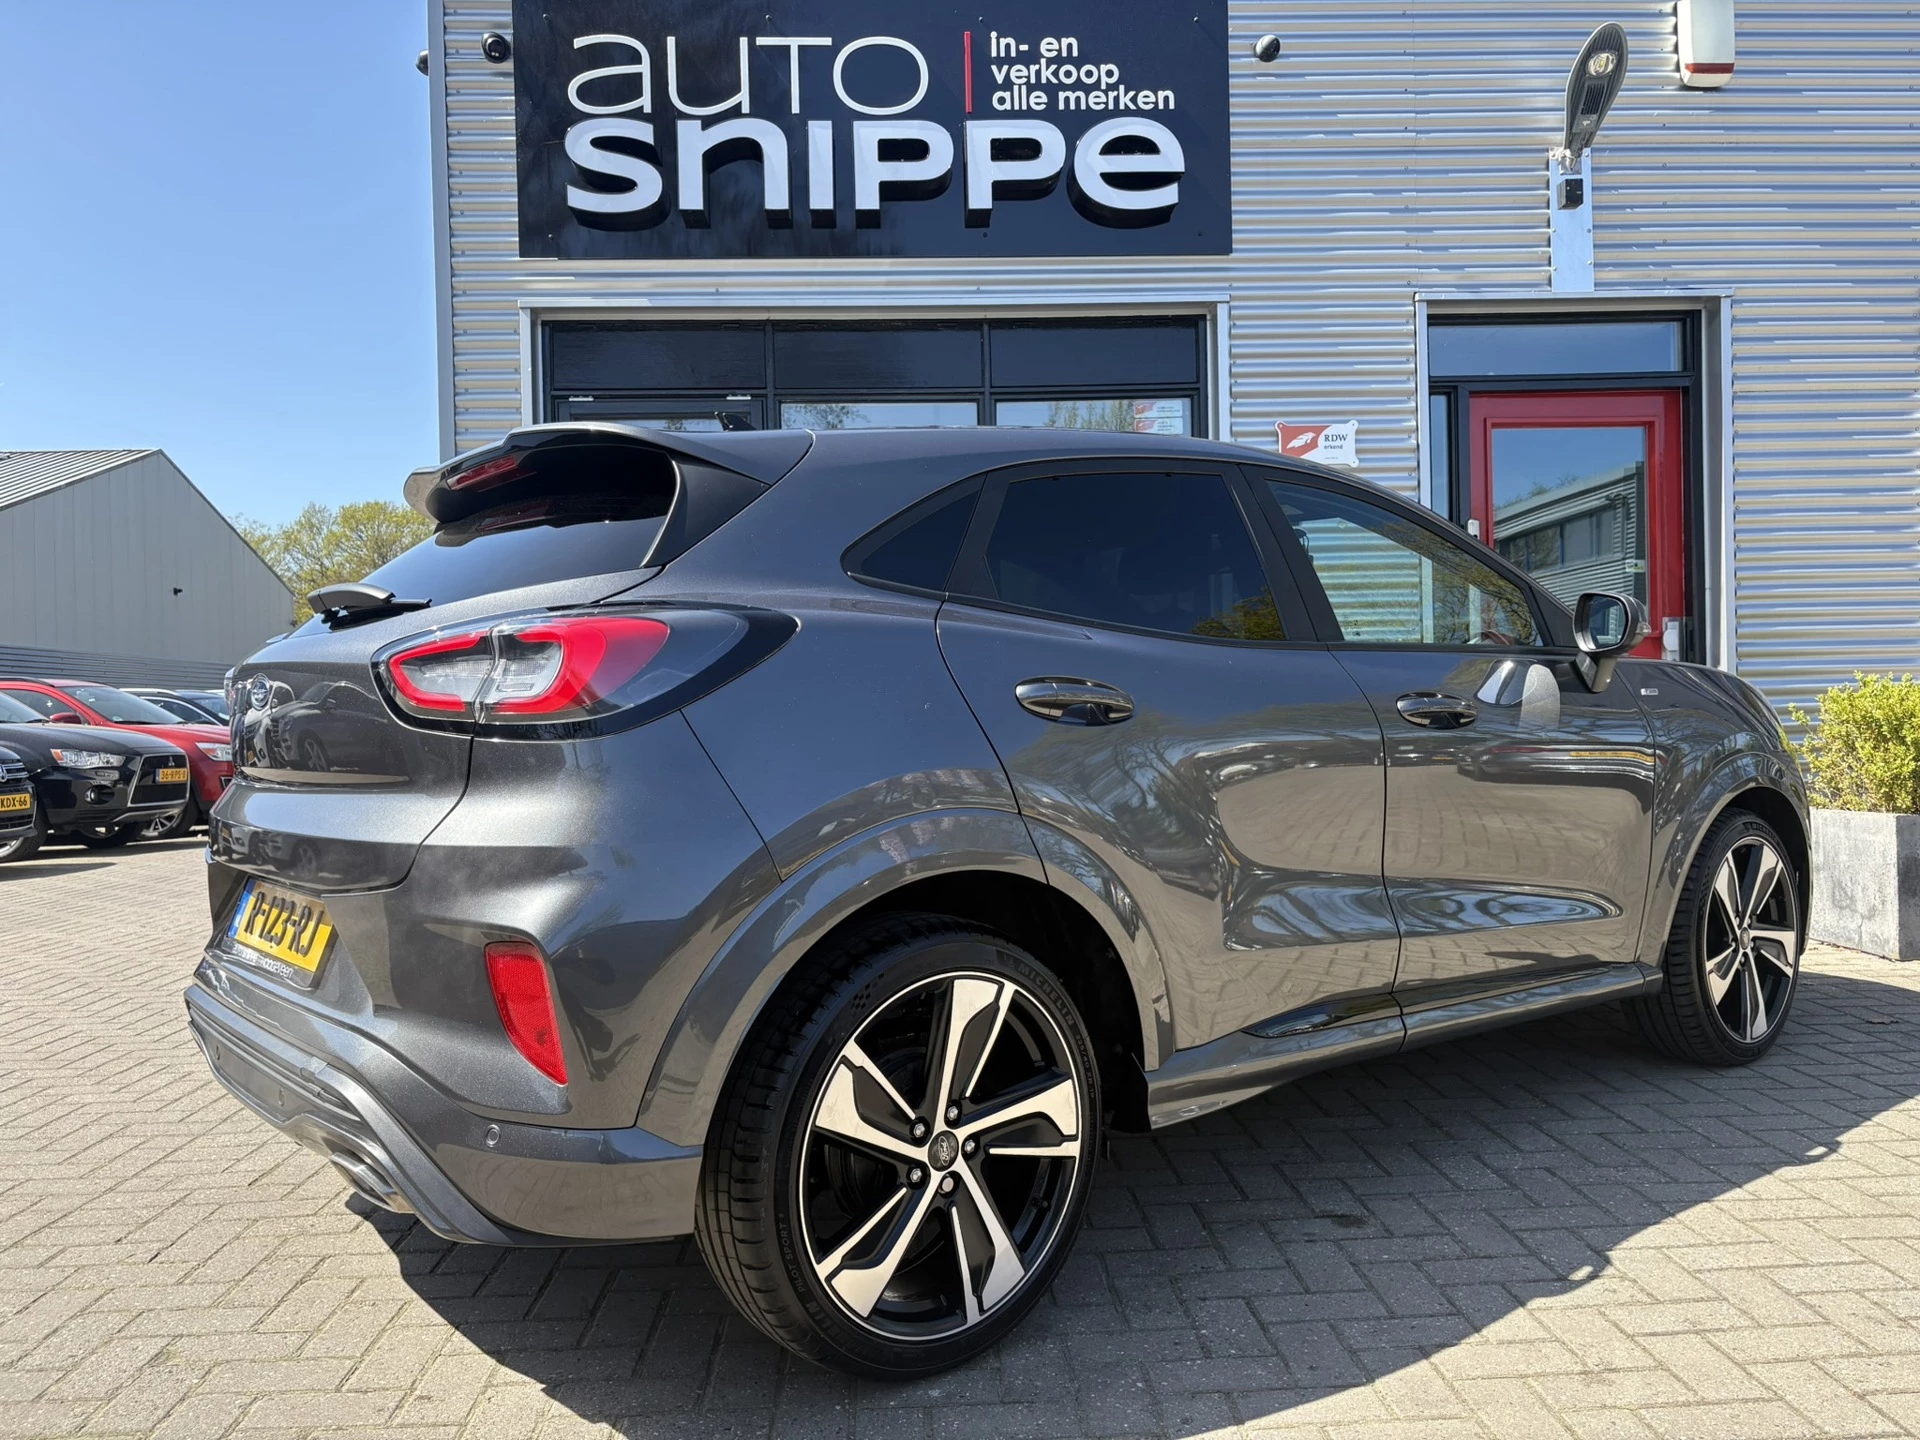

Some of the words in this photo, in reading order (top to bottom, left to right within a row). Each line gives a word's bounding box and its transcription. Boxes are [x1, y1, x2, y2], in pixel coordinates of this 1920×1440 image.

[990, 31, 1029, 58] in-
[1040, 37, 1079, 58] en
[990, 58, 1120, 90] verkoop
[992, 85, 1048, 111] alle
[1058, 85, 1175, 111] merken
[1324, 434, 1348, 443] RDW
[0, 795, 28, 809] KDX-66
[243, 891, 325, 958] R-123-RJ
[1017, 963, 1075, 1027] MICHELIN
[779, 1223, 794, 1260] SPORT
[788, 1263, 807, 1293] PILOT
